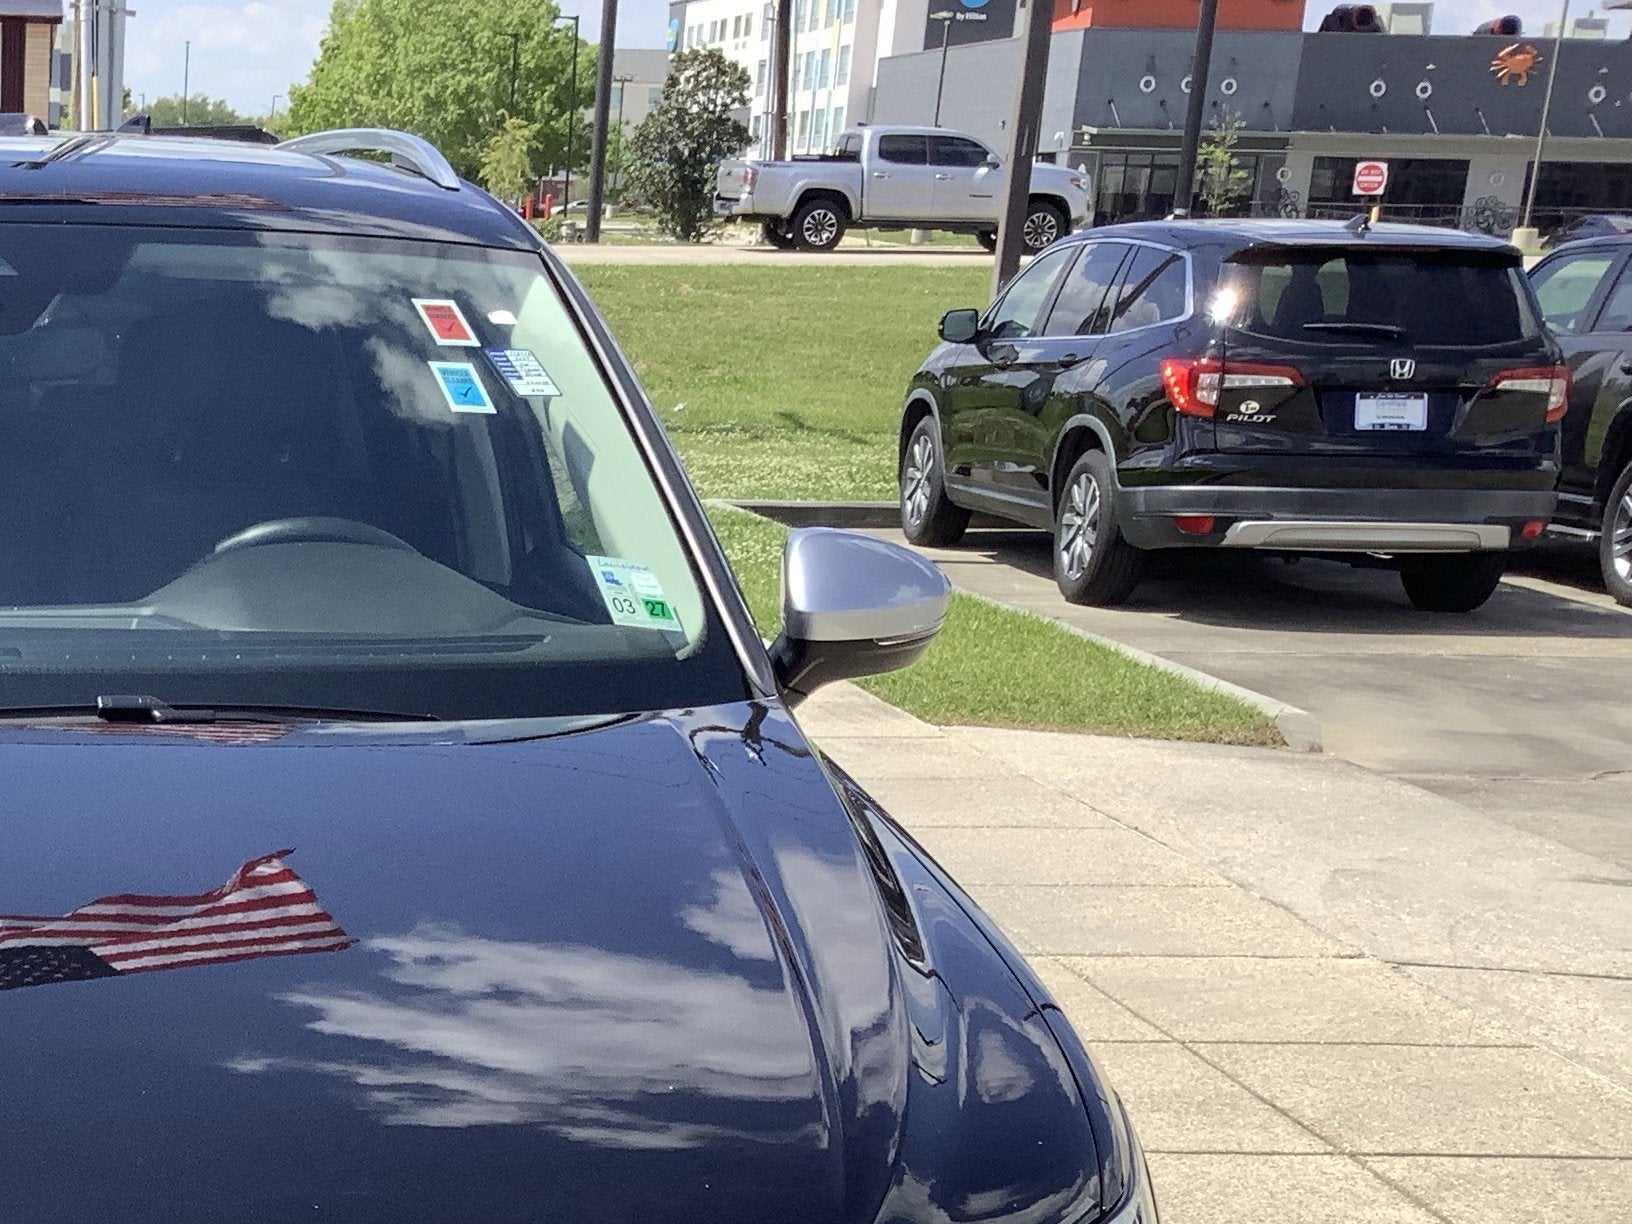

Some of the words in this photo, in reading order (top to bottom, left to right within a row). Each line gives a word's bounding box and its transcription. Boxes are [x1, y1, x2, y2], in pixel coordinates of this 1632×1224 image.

[1226, 413, 1277, 423] PILOT
[612, 597, 636, 615] 03
[645, 601, 666, 617] 27
